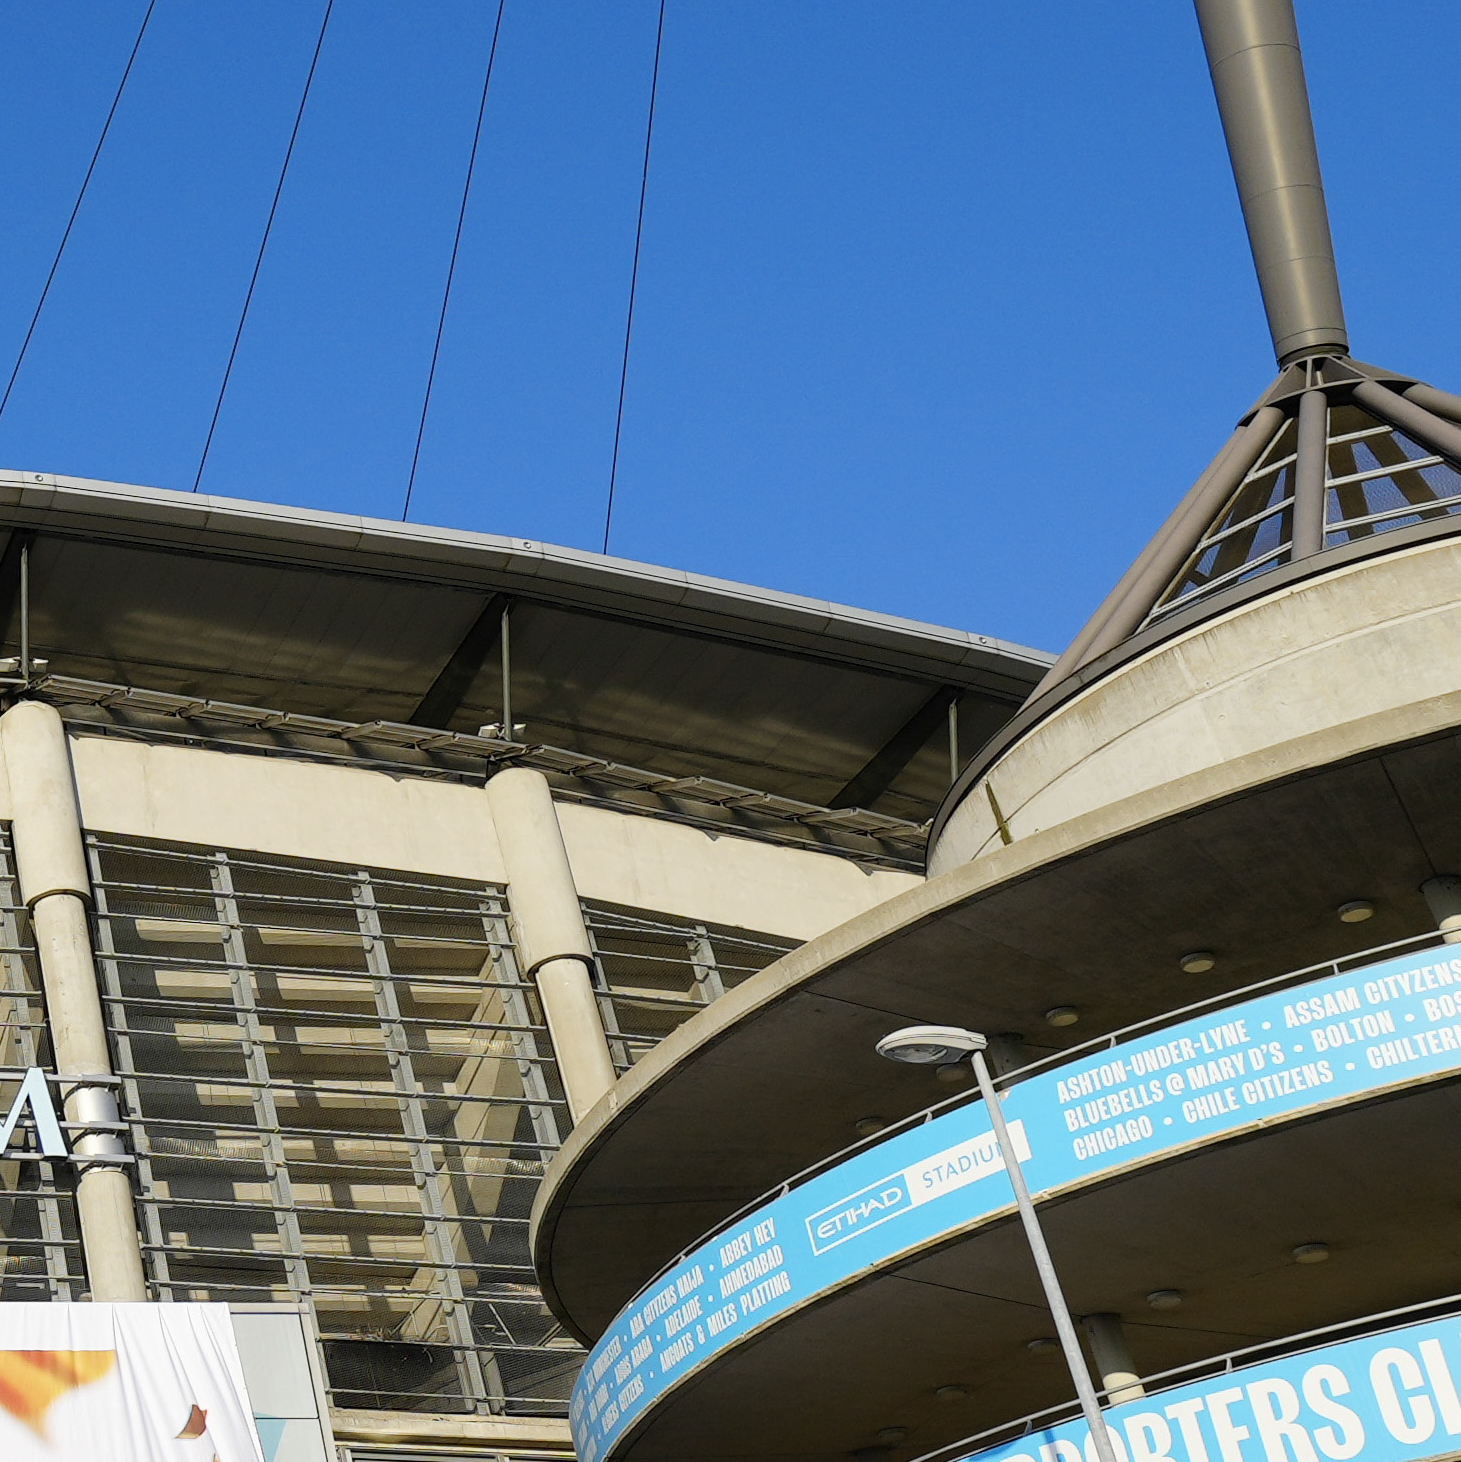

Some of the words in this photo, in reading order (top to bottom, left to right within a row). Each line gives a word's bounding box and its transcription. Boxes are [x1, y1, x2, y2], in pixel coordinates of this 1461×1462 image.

[1056, 1018, 1251, 1104] ASHTON-UNDER-LYNE
[1283, 986, 1361, 1029] ASSAM
[1364, 957, 1461, 1005] CITYZENS
[1064, 1079, 1165, 1132] BLUEBELLS
[1166, 1072, 1185, 1096] @
[1186, 1050, 1245, 1091] MARY
[1312, 1010, 1396, 1053] BOLTON
[1073, 1115, 1154, 1160] CHICAGO
[1182, 1086, 1240, 1124] CHILE
[1242, 1059, 1334, 1106] CITIZENS
[719, 1231, 752, 1268] ABBEY
[753, 1217, 777, 1248] HEY
[817, 1187, 902, 1239] ETIHAD
[697, 1325, 706, 1345] &
[706, 1303, 738, 1337] MILES
[740, 1271, 792, 1316] PLATTING
[719, 1244, 785, 1299] AHMEDABAD
